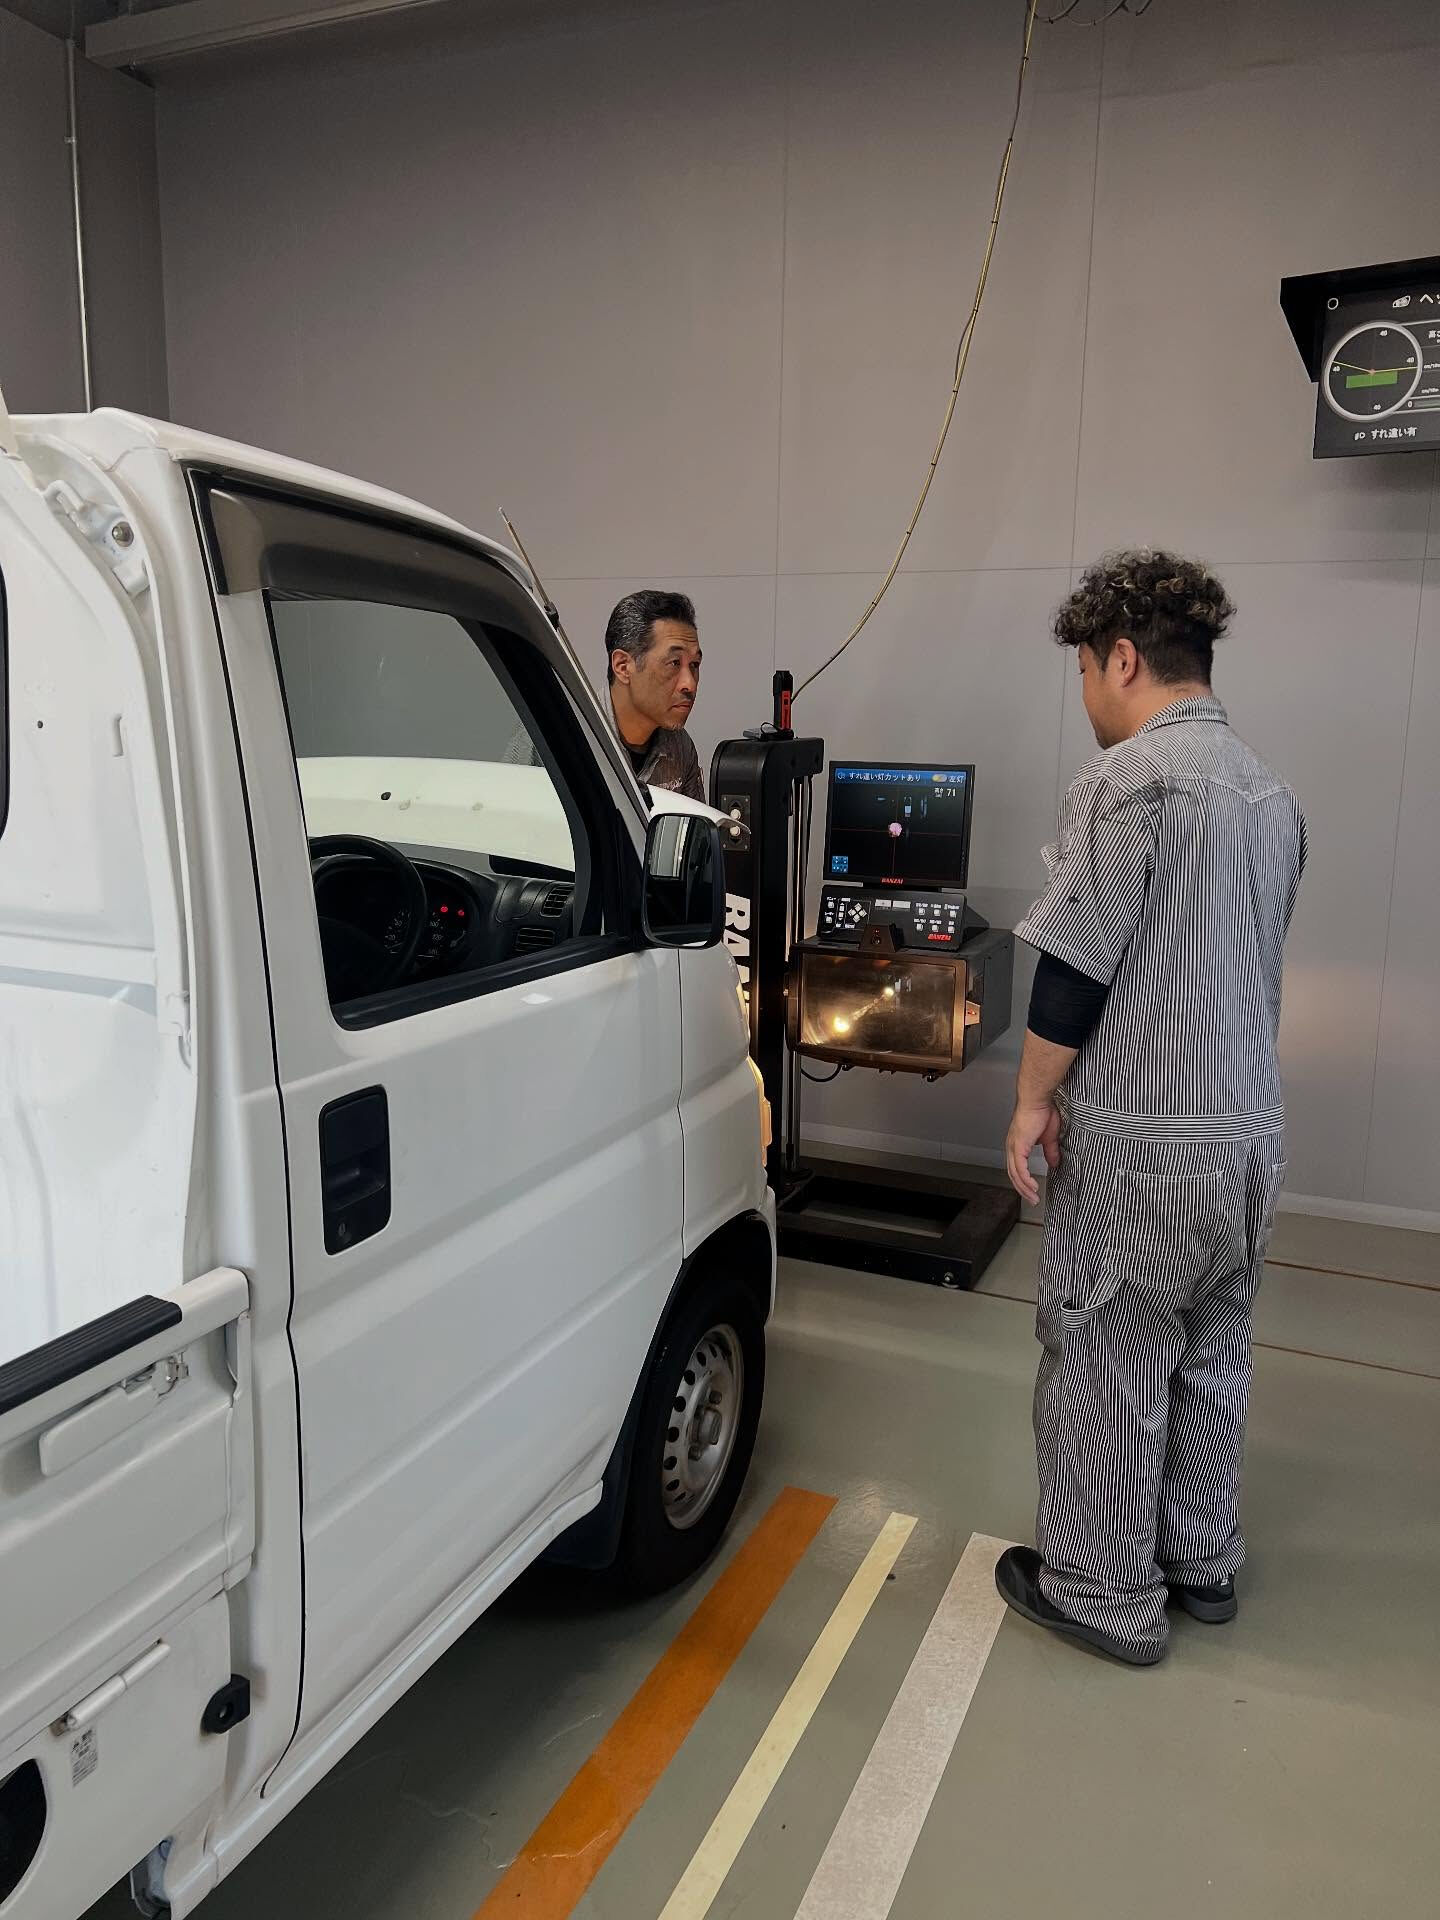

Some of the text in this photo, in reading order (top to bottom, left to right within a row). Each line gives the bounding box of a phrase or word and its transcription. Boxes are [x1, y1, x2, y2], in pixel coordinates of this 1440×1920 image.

[1371, 427, 1417, 440] すれ違い有
[946, 788, 956, 797] 71
